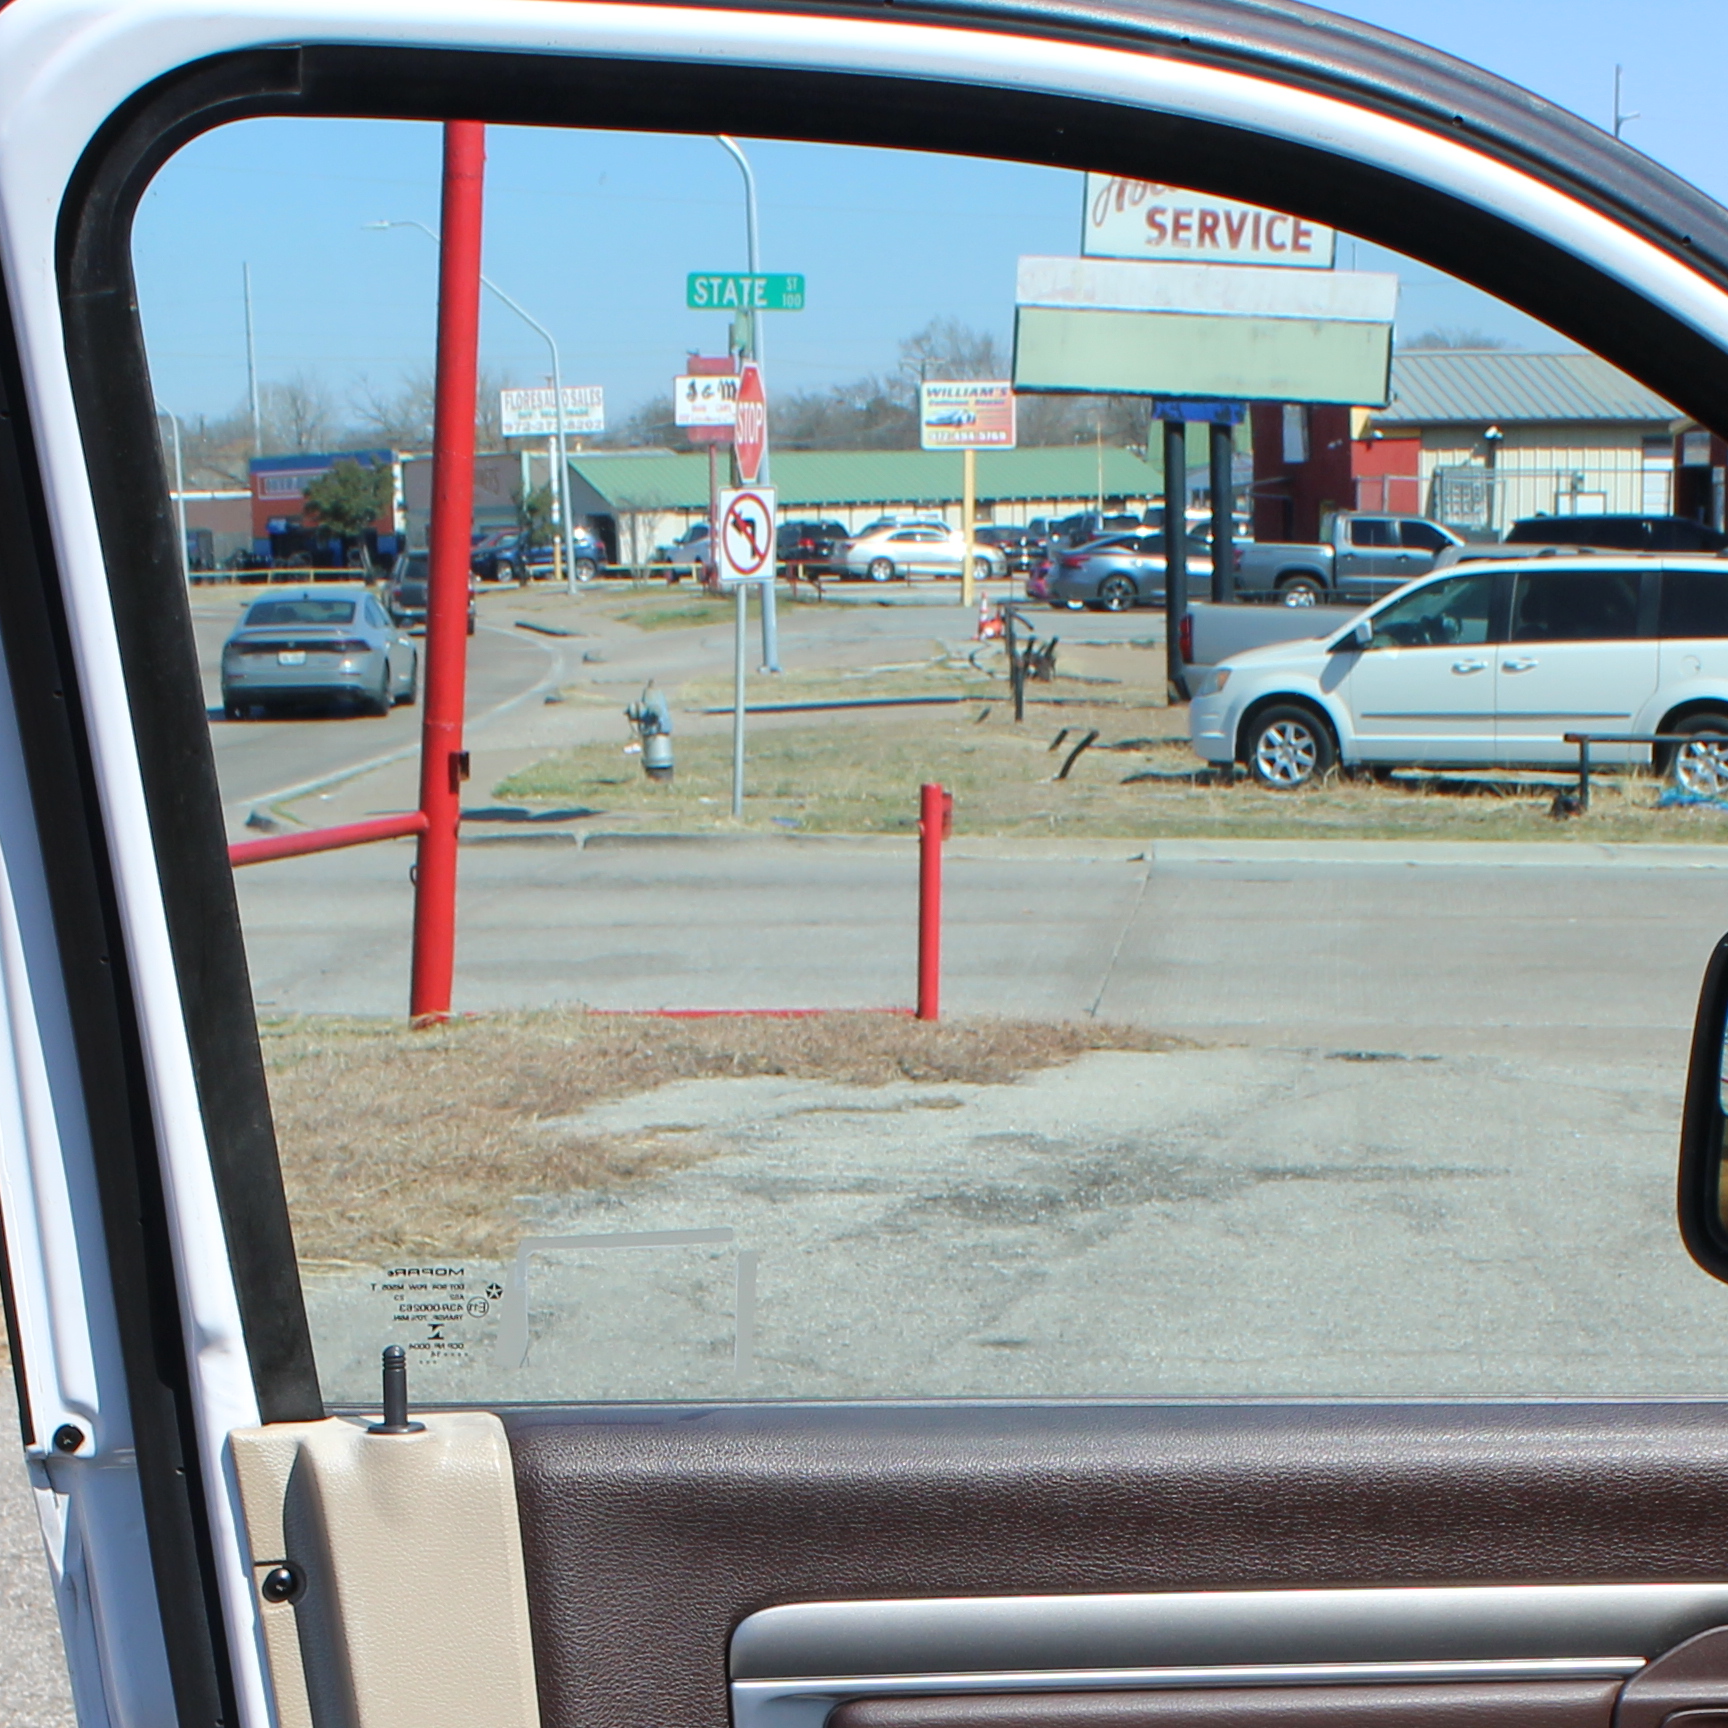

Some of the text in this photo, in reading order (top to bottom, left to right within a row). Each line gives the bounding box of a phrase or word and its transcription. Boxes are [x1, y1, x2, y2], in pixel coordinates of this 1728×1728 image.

[1144, 205, 1314, 254] SERVICE
[693, 275, 799, 307] STATE ST
[782, 292, 803, 308] 100
[504, 386, 603, 412] FLORES AUO SALES
[926, 386, 1009, 398] WILLIAM'S
[736, 402, 764, 444] STOP
